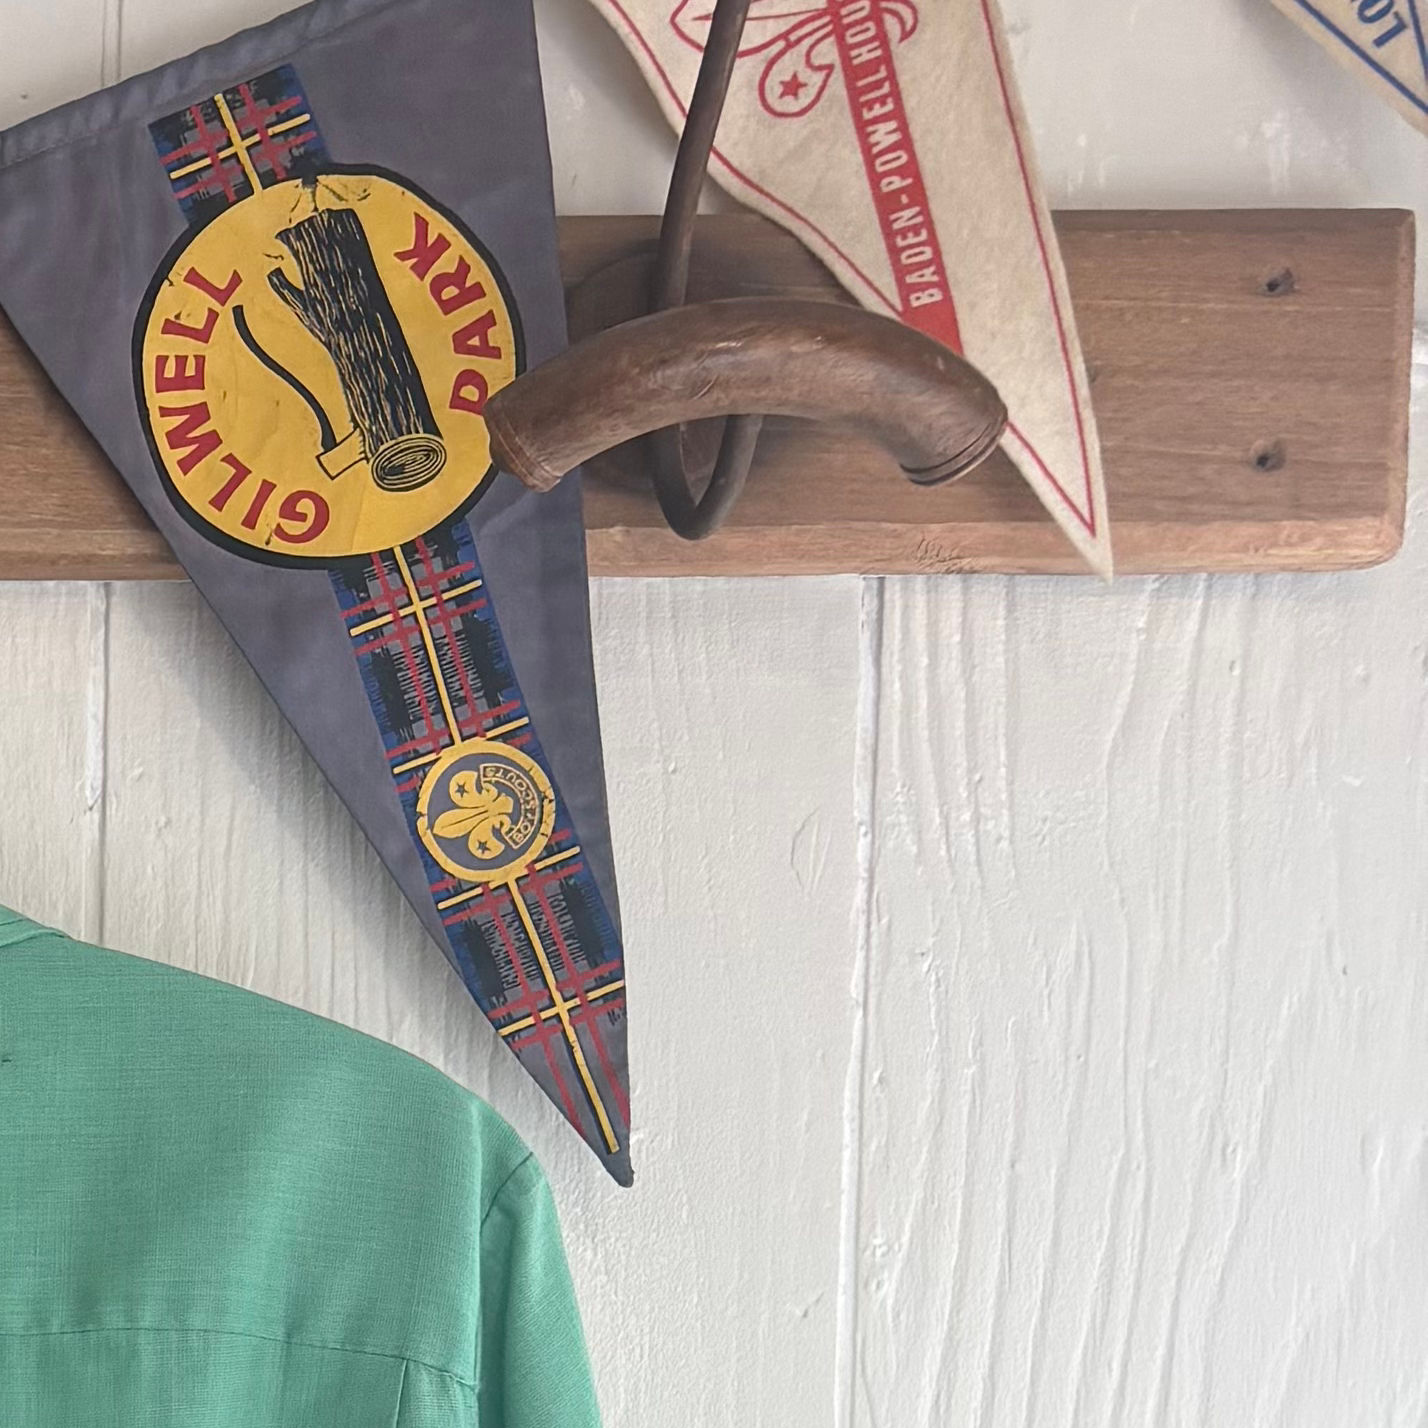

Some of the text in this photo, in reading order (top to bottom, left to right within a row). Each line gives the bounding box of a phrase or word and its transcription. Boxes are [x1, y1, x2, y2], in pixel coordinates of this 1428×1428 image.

[856, 65, 944, 309] BADEN-POWELL
[154, 211, 502, 544] GILWELL PARK
